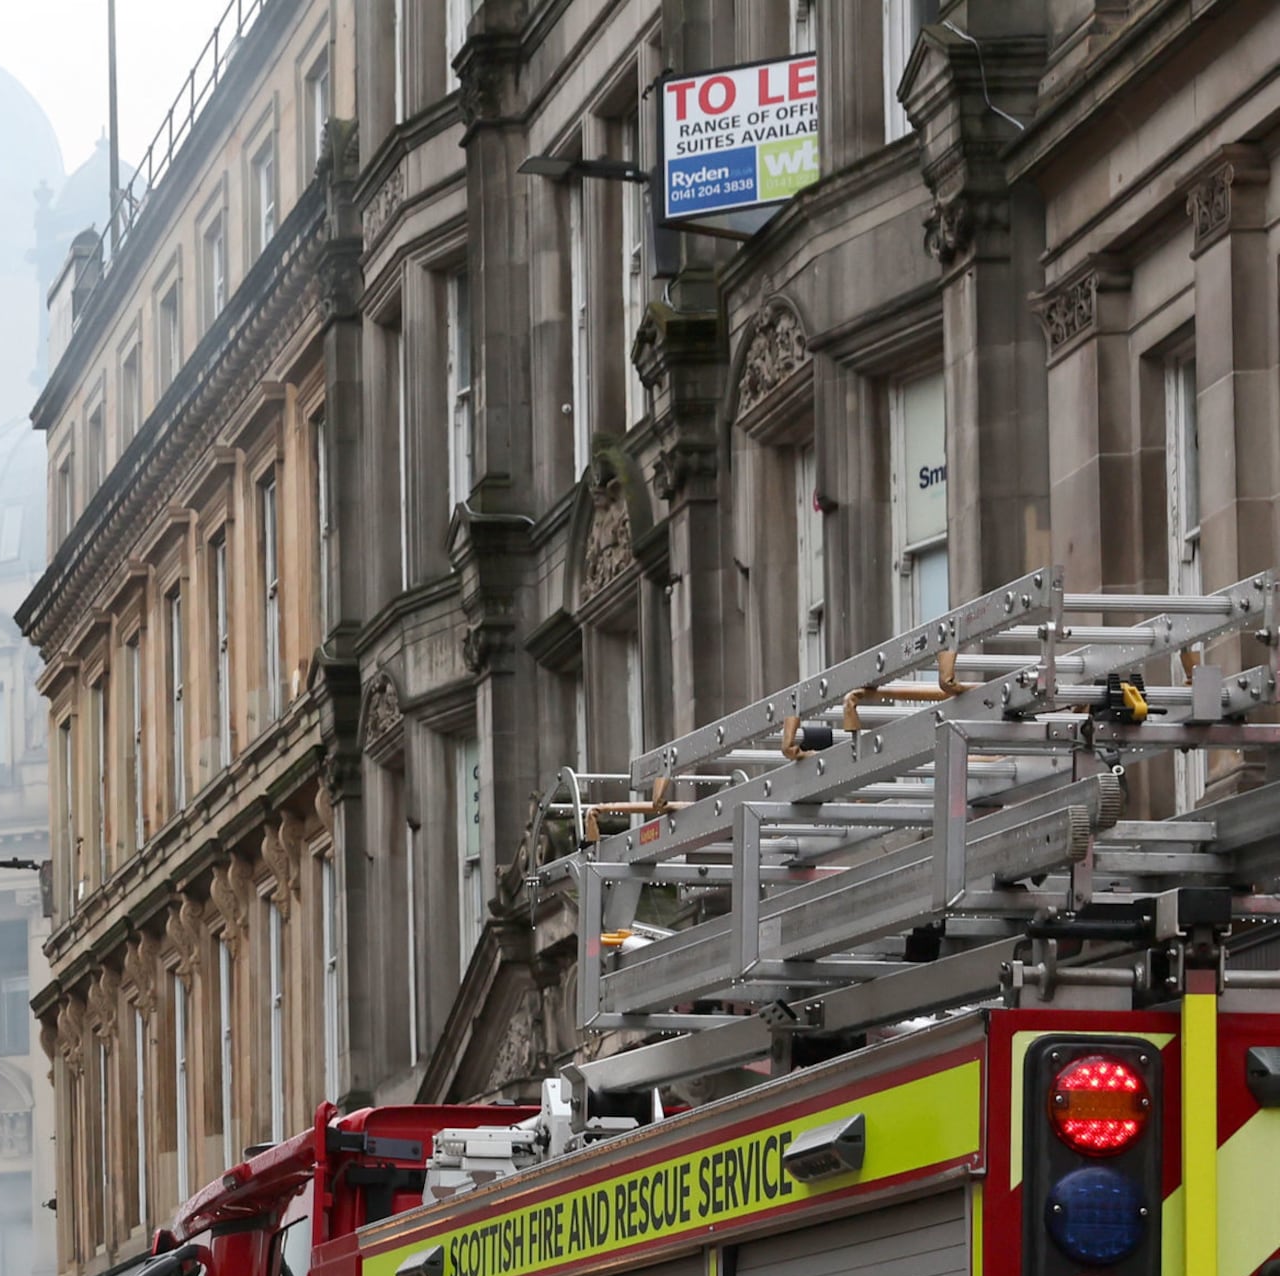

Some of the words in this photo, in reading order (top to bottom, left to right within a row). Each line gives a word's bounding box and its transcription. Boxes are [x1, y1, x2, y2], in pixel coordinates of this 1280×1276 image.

[667, 75, 737, 121] TO
[758, 59, 817, 106] LE
[680, 115, 741, 137] RANGE
[747, 110, 770, 126] OF
[676, 133, 735, 155] SUITES
[671, 166, 729, 188] Ryden
[671, 188, 695, 201] 0141
[698, 184, 720, 197] 204
[723, 178, 754, 193] 3838
[528, 1201, 564, 1264] FIRE
[568, 1189, 609, 1254] AND
[614, 1162, 691, 1241] RESCUE
[698, 1131, 793, 1217] SERVICE
